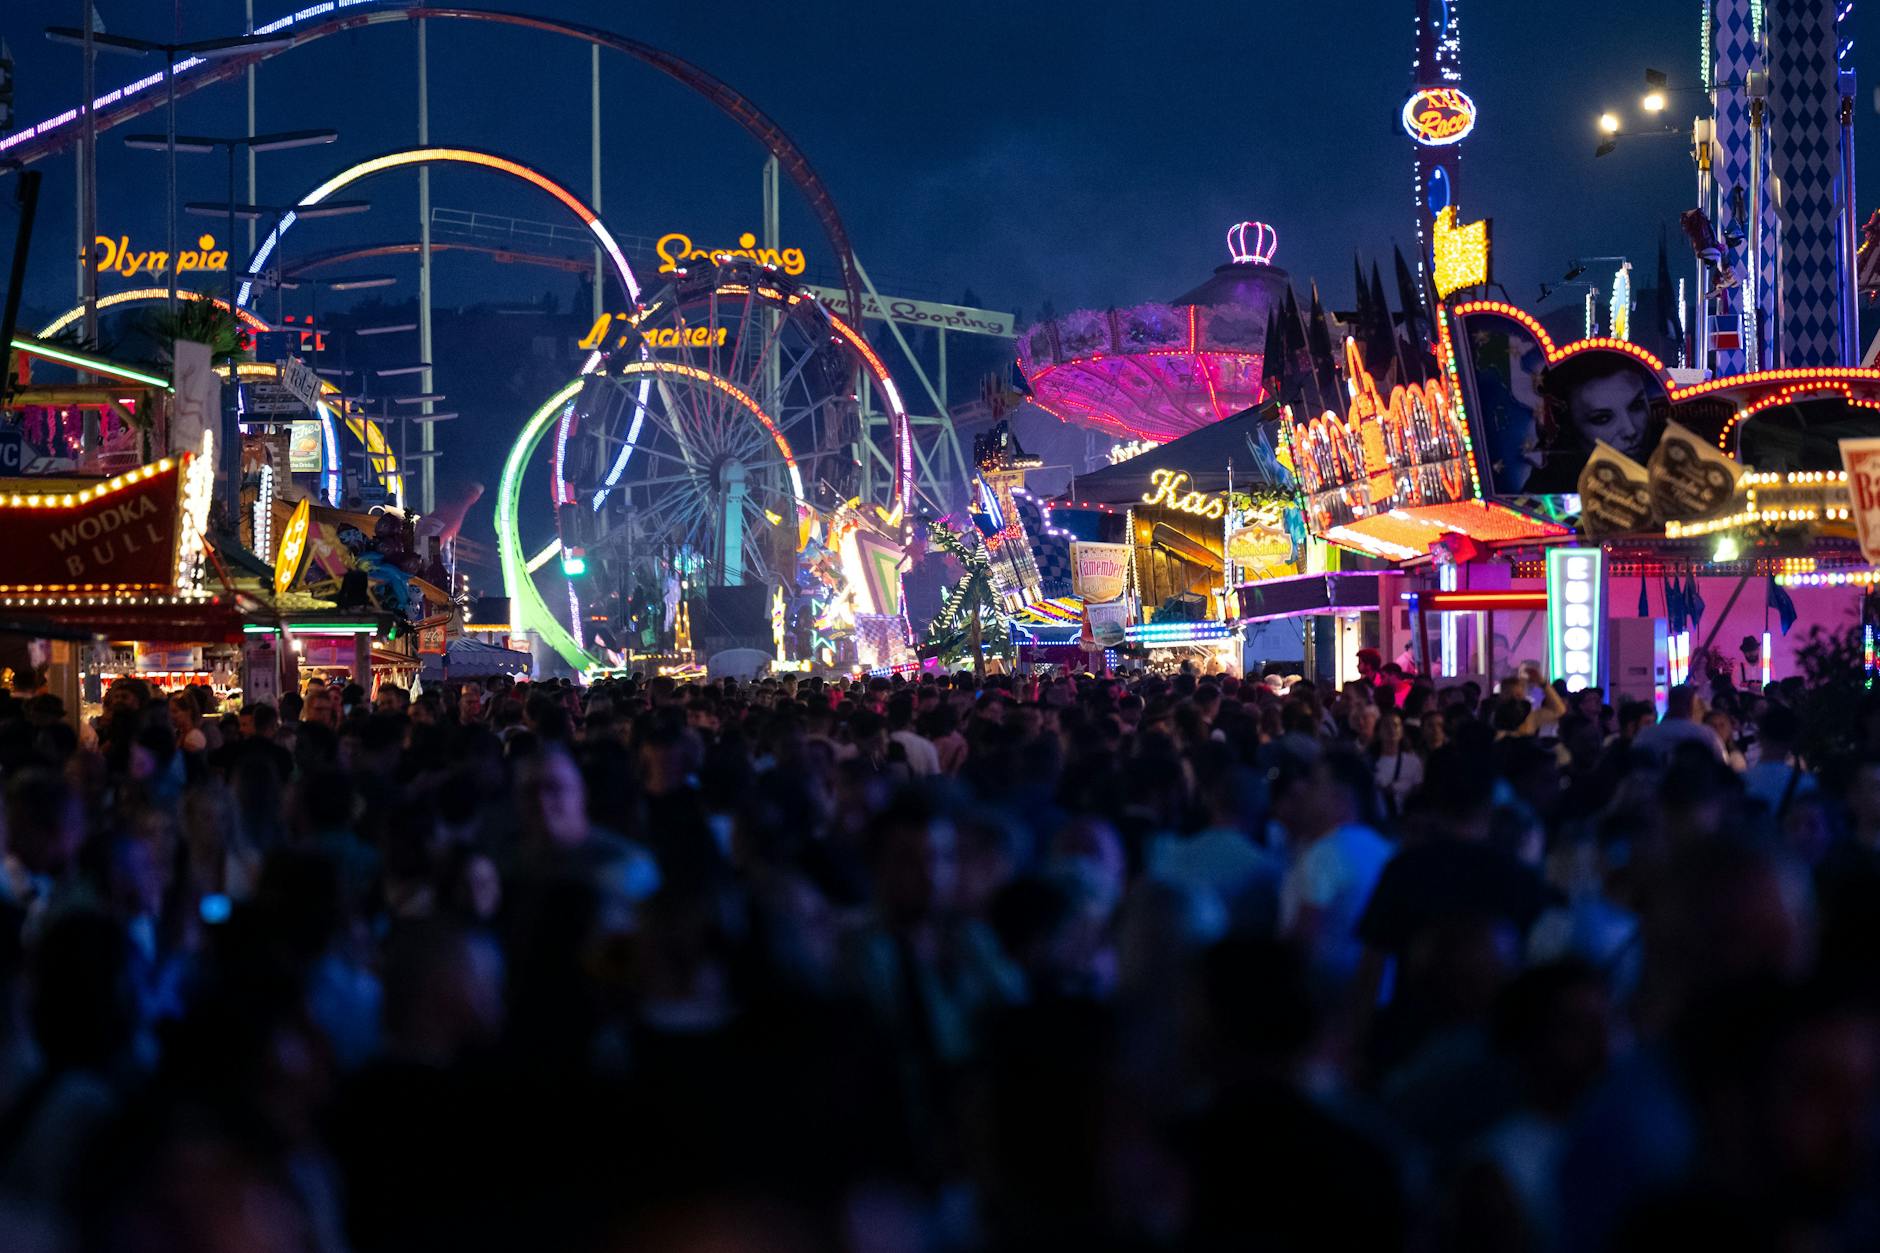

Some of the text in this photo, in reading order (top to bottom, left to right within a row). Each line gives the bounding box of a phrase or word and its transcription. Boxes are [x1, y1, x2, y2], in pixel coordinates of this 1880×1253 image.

[656, 232, 805, 276] Ling
[578, 312, 728, 348] Mnchen
[890, 302, 1004, 335] Looping
[0, 443, 18, 467] C
[48, 494, 159, 551] WODKA
[65, 522, 164, 577] BULL
